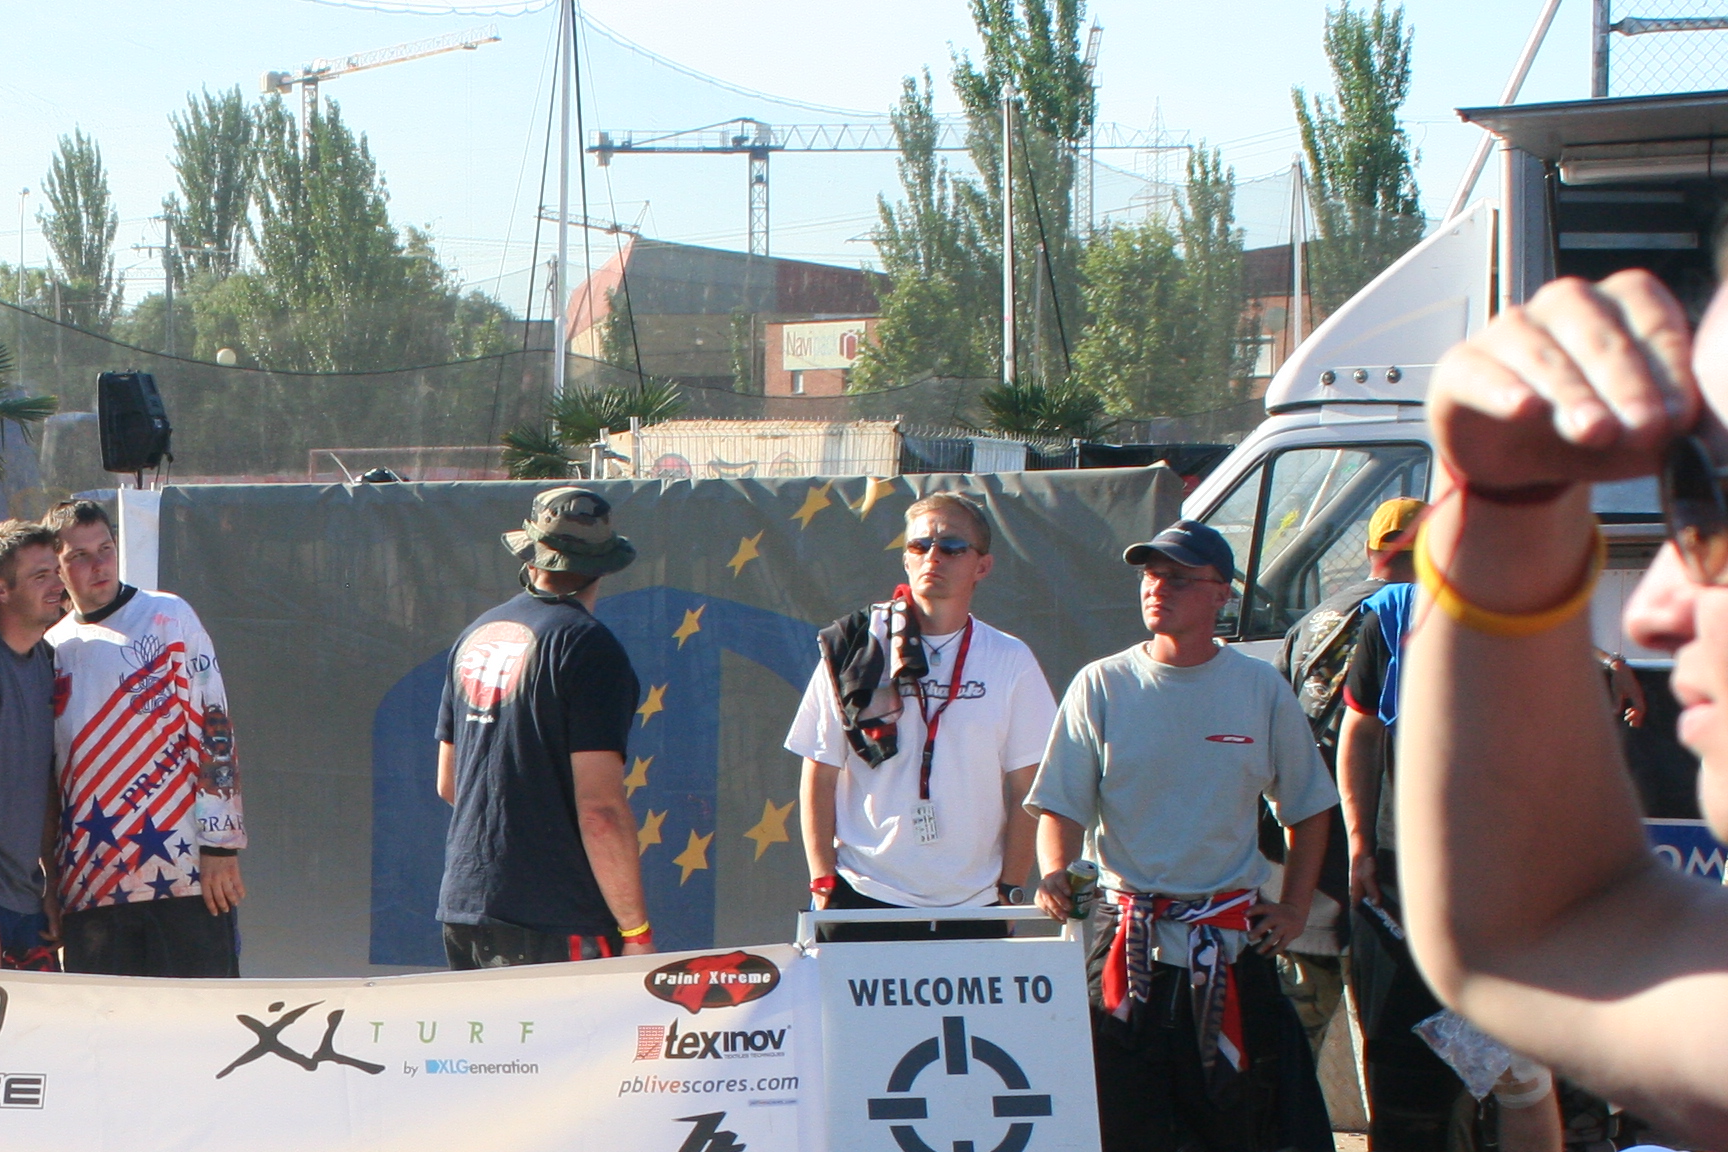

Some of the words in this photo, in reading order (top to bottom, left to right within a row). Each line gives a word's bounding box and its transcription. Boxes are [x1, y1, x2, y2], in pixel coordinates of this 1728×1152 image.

[654, 972, 700, 985] Paint
[708, 970, 771, 985] Xtreme
[848, 976, 1003, 1007] WELCOME
[1014, 975, 1053, 1004] TO
[369, 1021, 534, 1044] TURF
[663, 1017, 787, 1060] texinov
[403, 1061, 419, 1078] by
[618, 1074, 799, 1097] pblivescores.com
